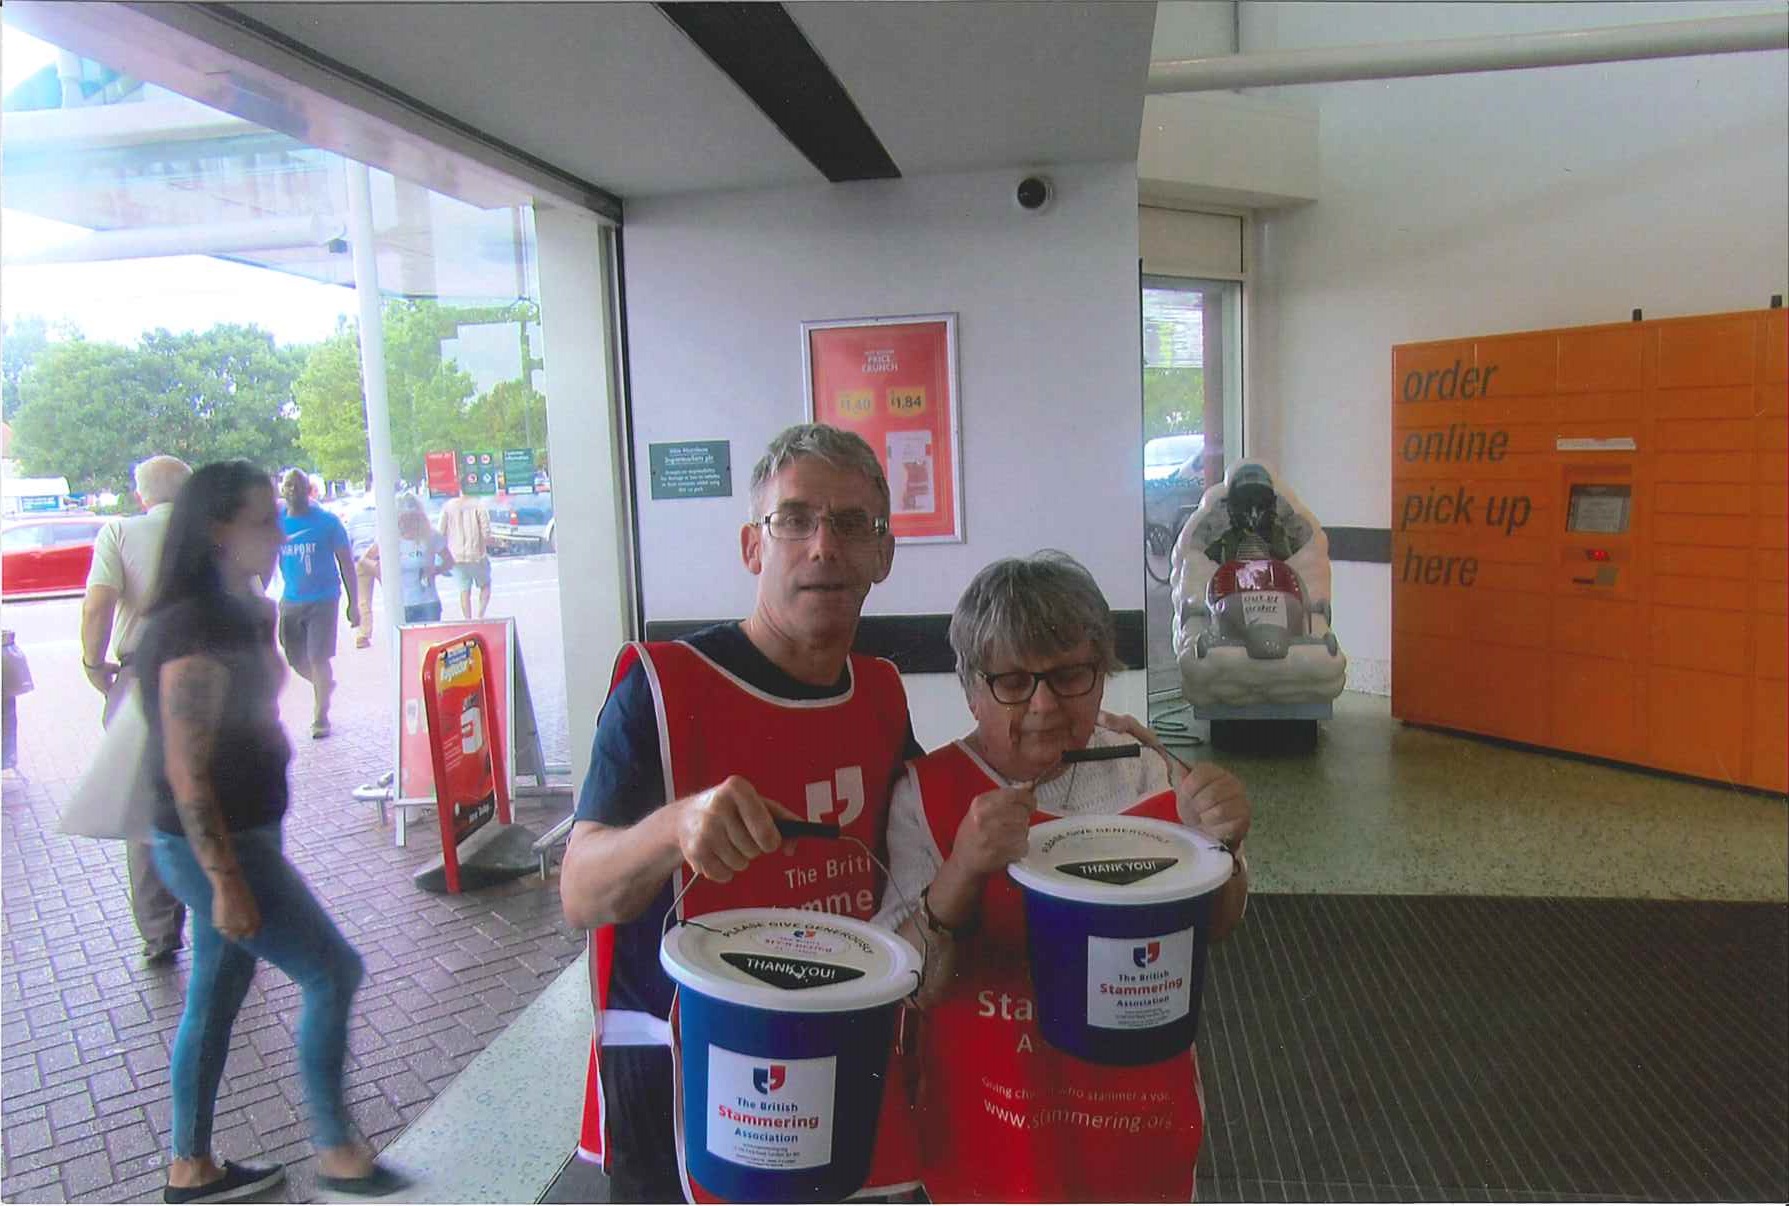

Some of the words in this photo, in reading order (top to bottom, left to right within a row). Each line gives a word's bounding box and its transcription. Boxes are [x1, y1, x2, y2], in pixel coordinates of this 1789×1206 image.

[1403, 359, 1499, 401] order
[1403, 422, 1510, 464] online
[1402, 486, 1476, 532] pick
[1486, 495, 1532, 536] up
[1402, 545, 1480, 588] here
[785, 865, 818, 889] The
[826, 852, 871, 879] Briti
[1079, 864, 1125, 874] THANK
[1127, 861, 1157, 872] YOU!
[747, 957, 796, 976] THANK
[800, 965, 837, 980] YOU!
[1118, 974, 1136, 983] The
[1139, 969, 1170, 982] British
[1099, 976, 1183, 996] Stammering
[978, 990, 1033, 1021] Sta
[1116, 995, 1170, 1008] Association
[1016, 1033, 1033, 1054] A
[737, 1097, 756, 1107] The
[760, 1101, 799, 1112] British
[718, 1105, 820, 1129] Stammering
[734, 1127, 799, 1144] Association
